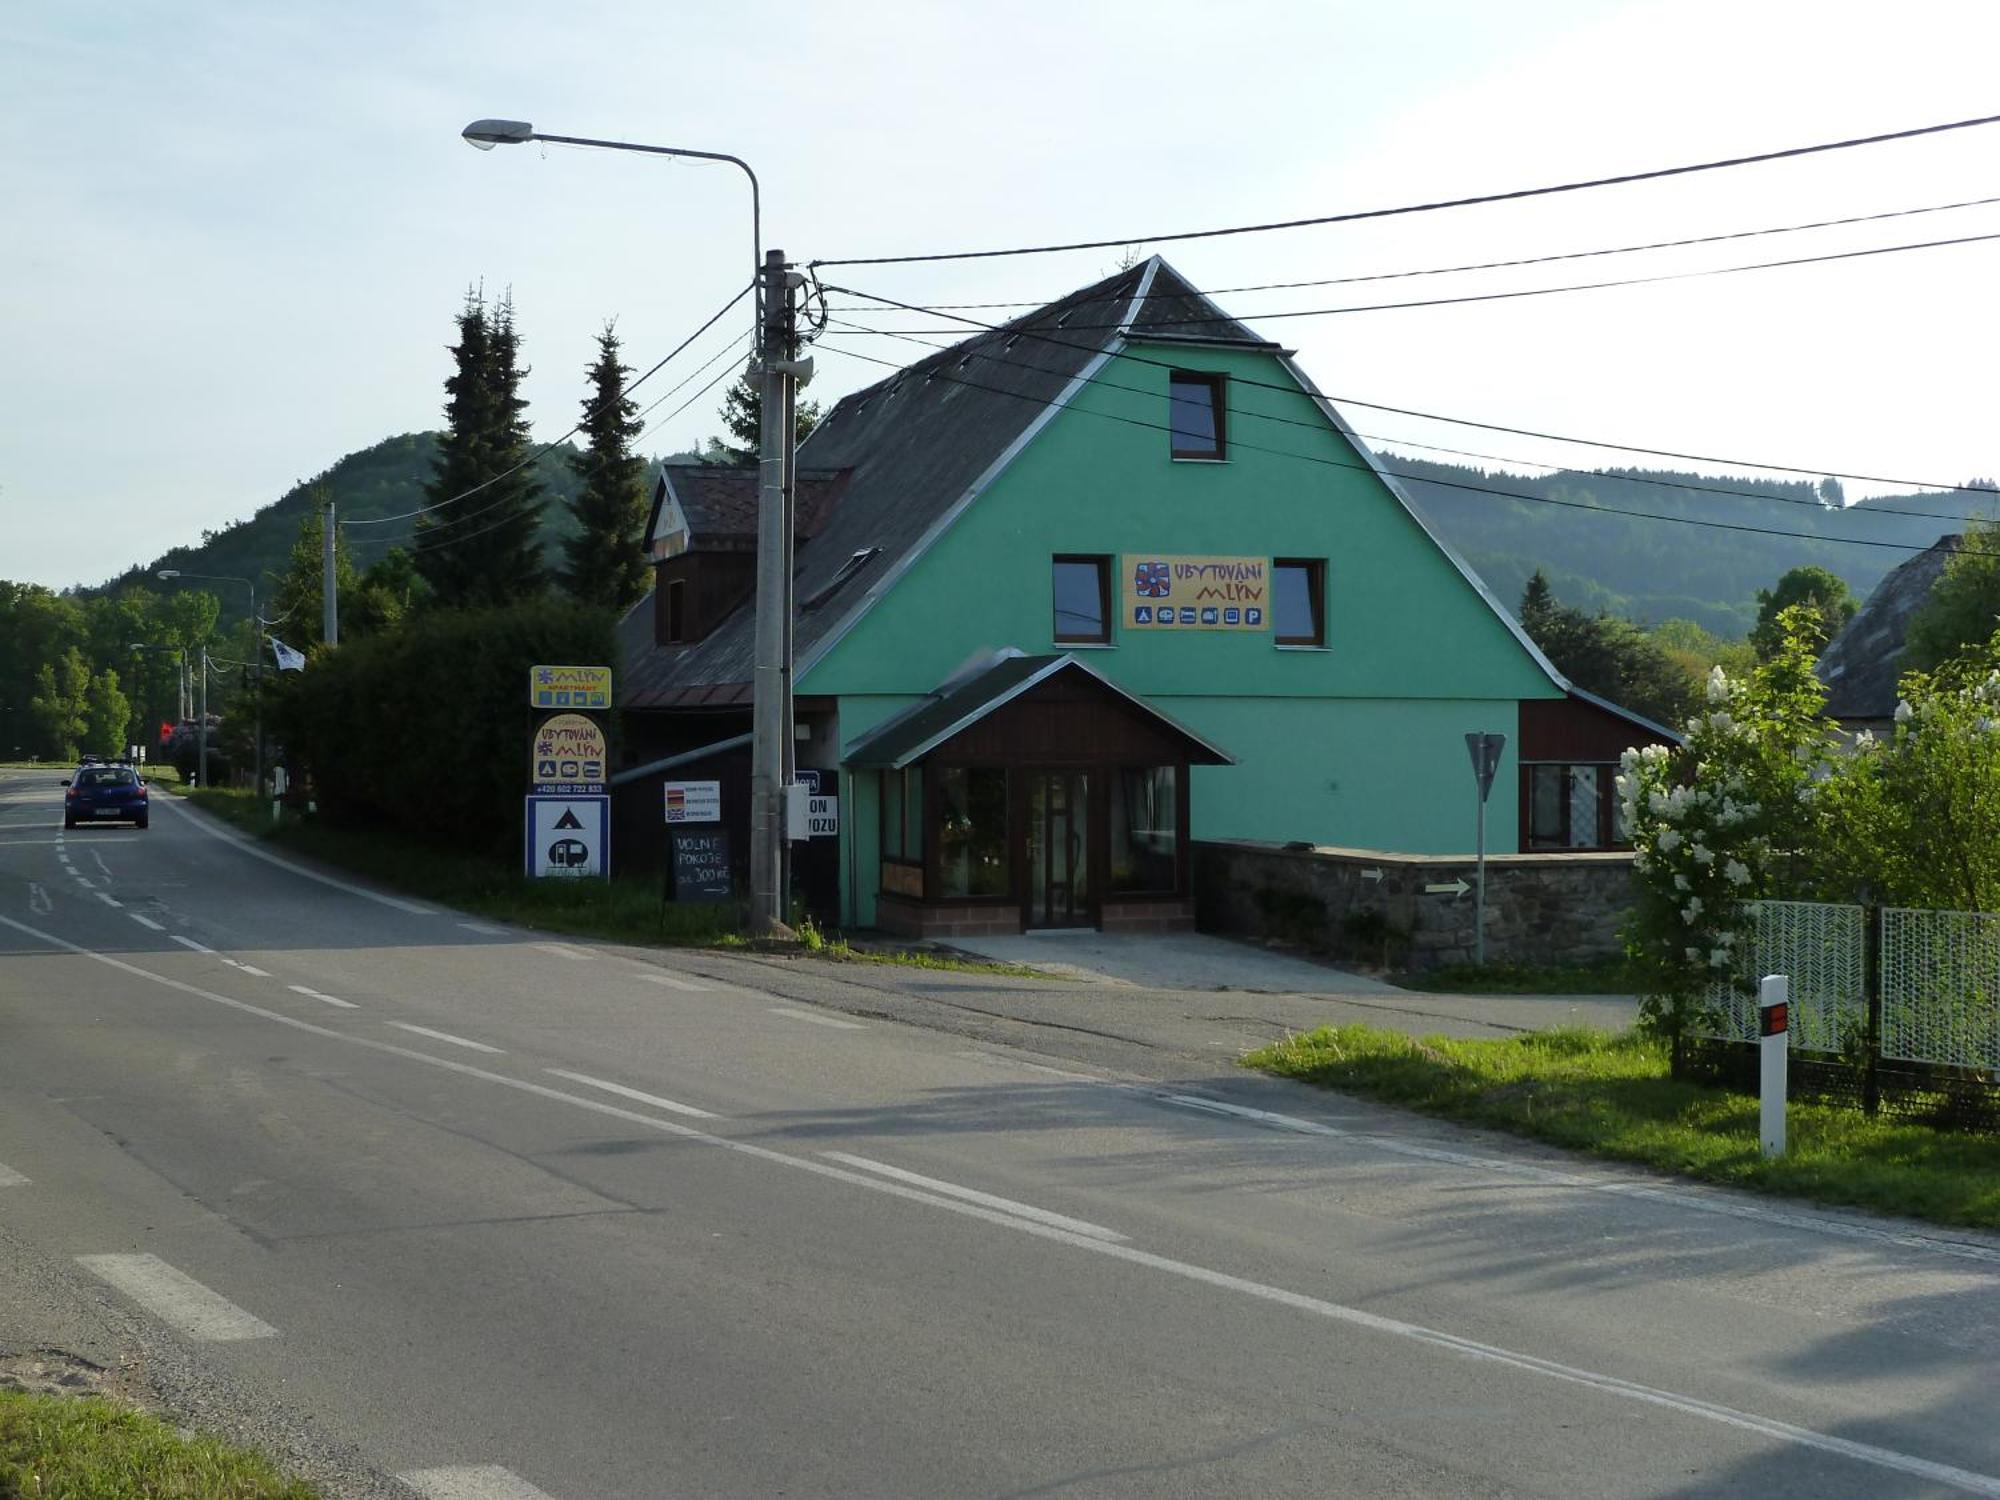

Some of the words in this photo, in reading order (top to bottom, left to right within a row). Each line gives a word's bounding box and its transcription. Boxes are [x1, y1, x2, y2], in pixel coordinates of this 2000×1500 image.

[1174, 562, 1263, 581] UBYTOVÁNÍ
[1196, 581, 1263, 601] MLÝN
[555, 740, 604, 757] MLÝN
